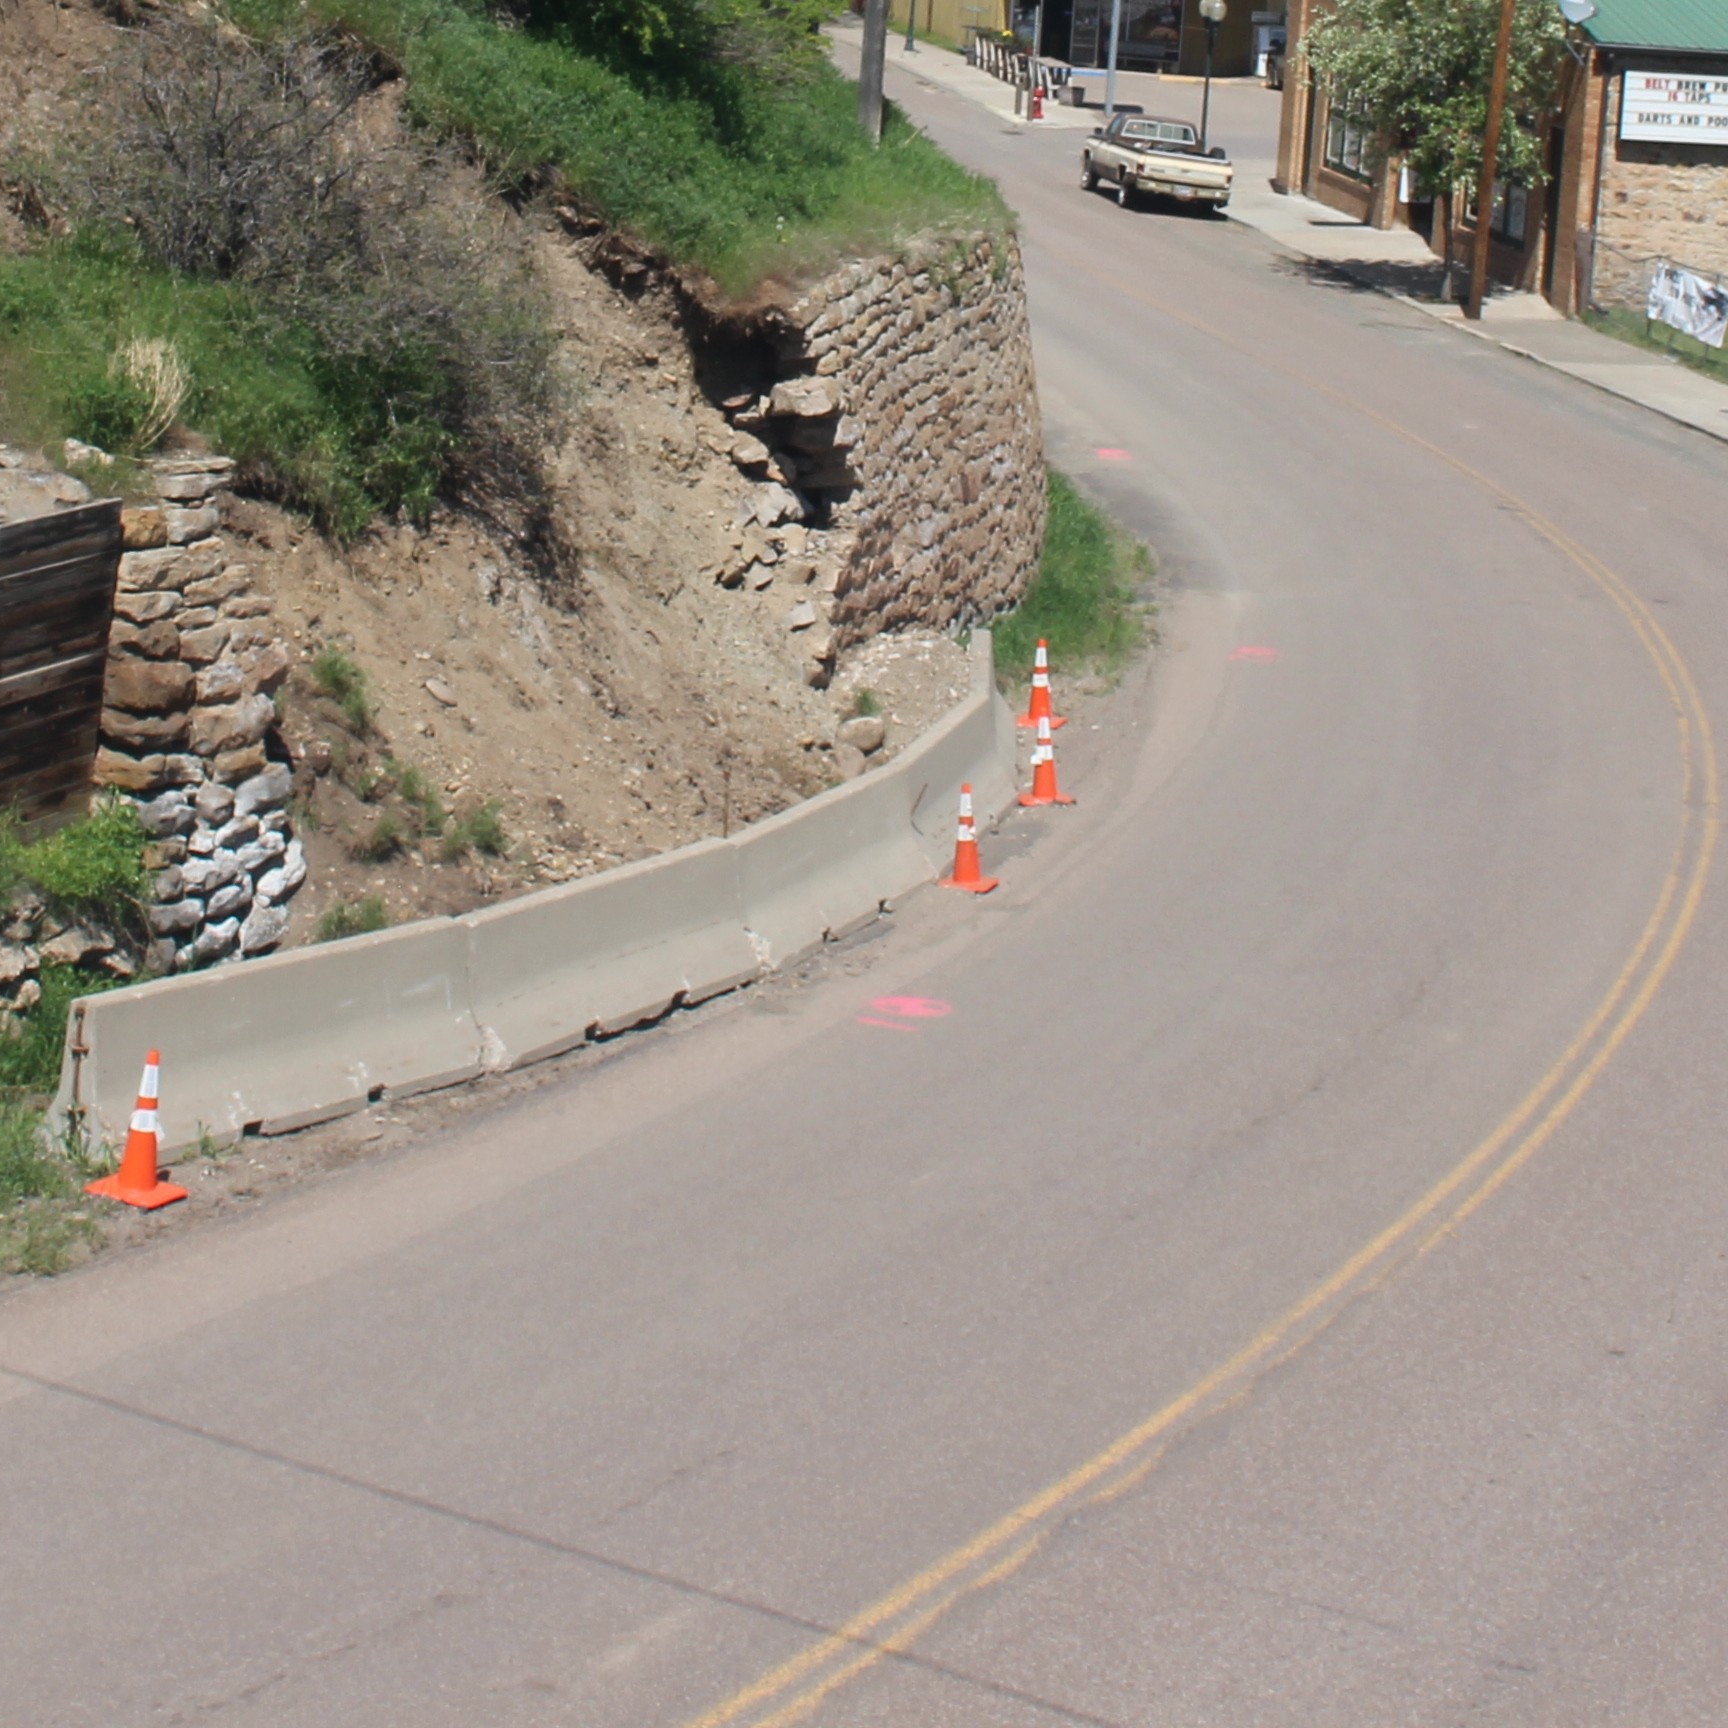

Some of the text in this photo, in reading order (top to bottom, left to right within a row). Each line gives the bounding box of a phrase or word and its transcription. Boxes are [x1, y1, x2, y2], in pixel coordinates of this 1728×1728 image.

[1645, 78, 1670, 89] BELT
[1677, 80, 1707, 91] BREW
[1685, 92, 1711, 103] TAPS
[1638, 113, 1672, 124] DARTS
[1679, 115, 1700, 125] AND
